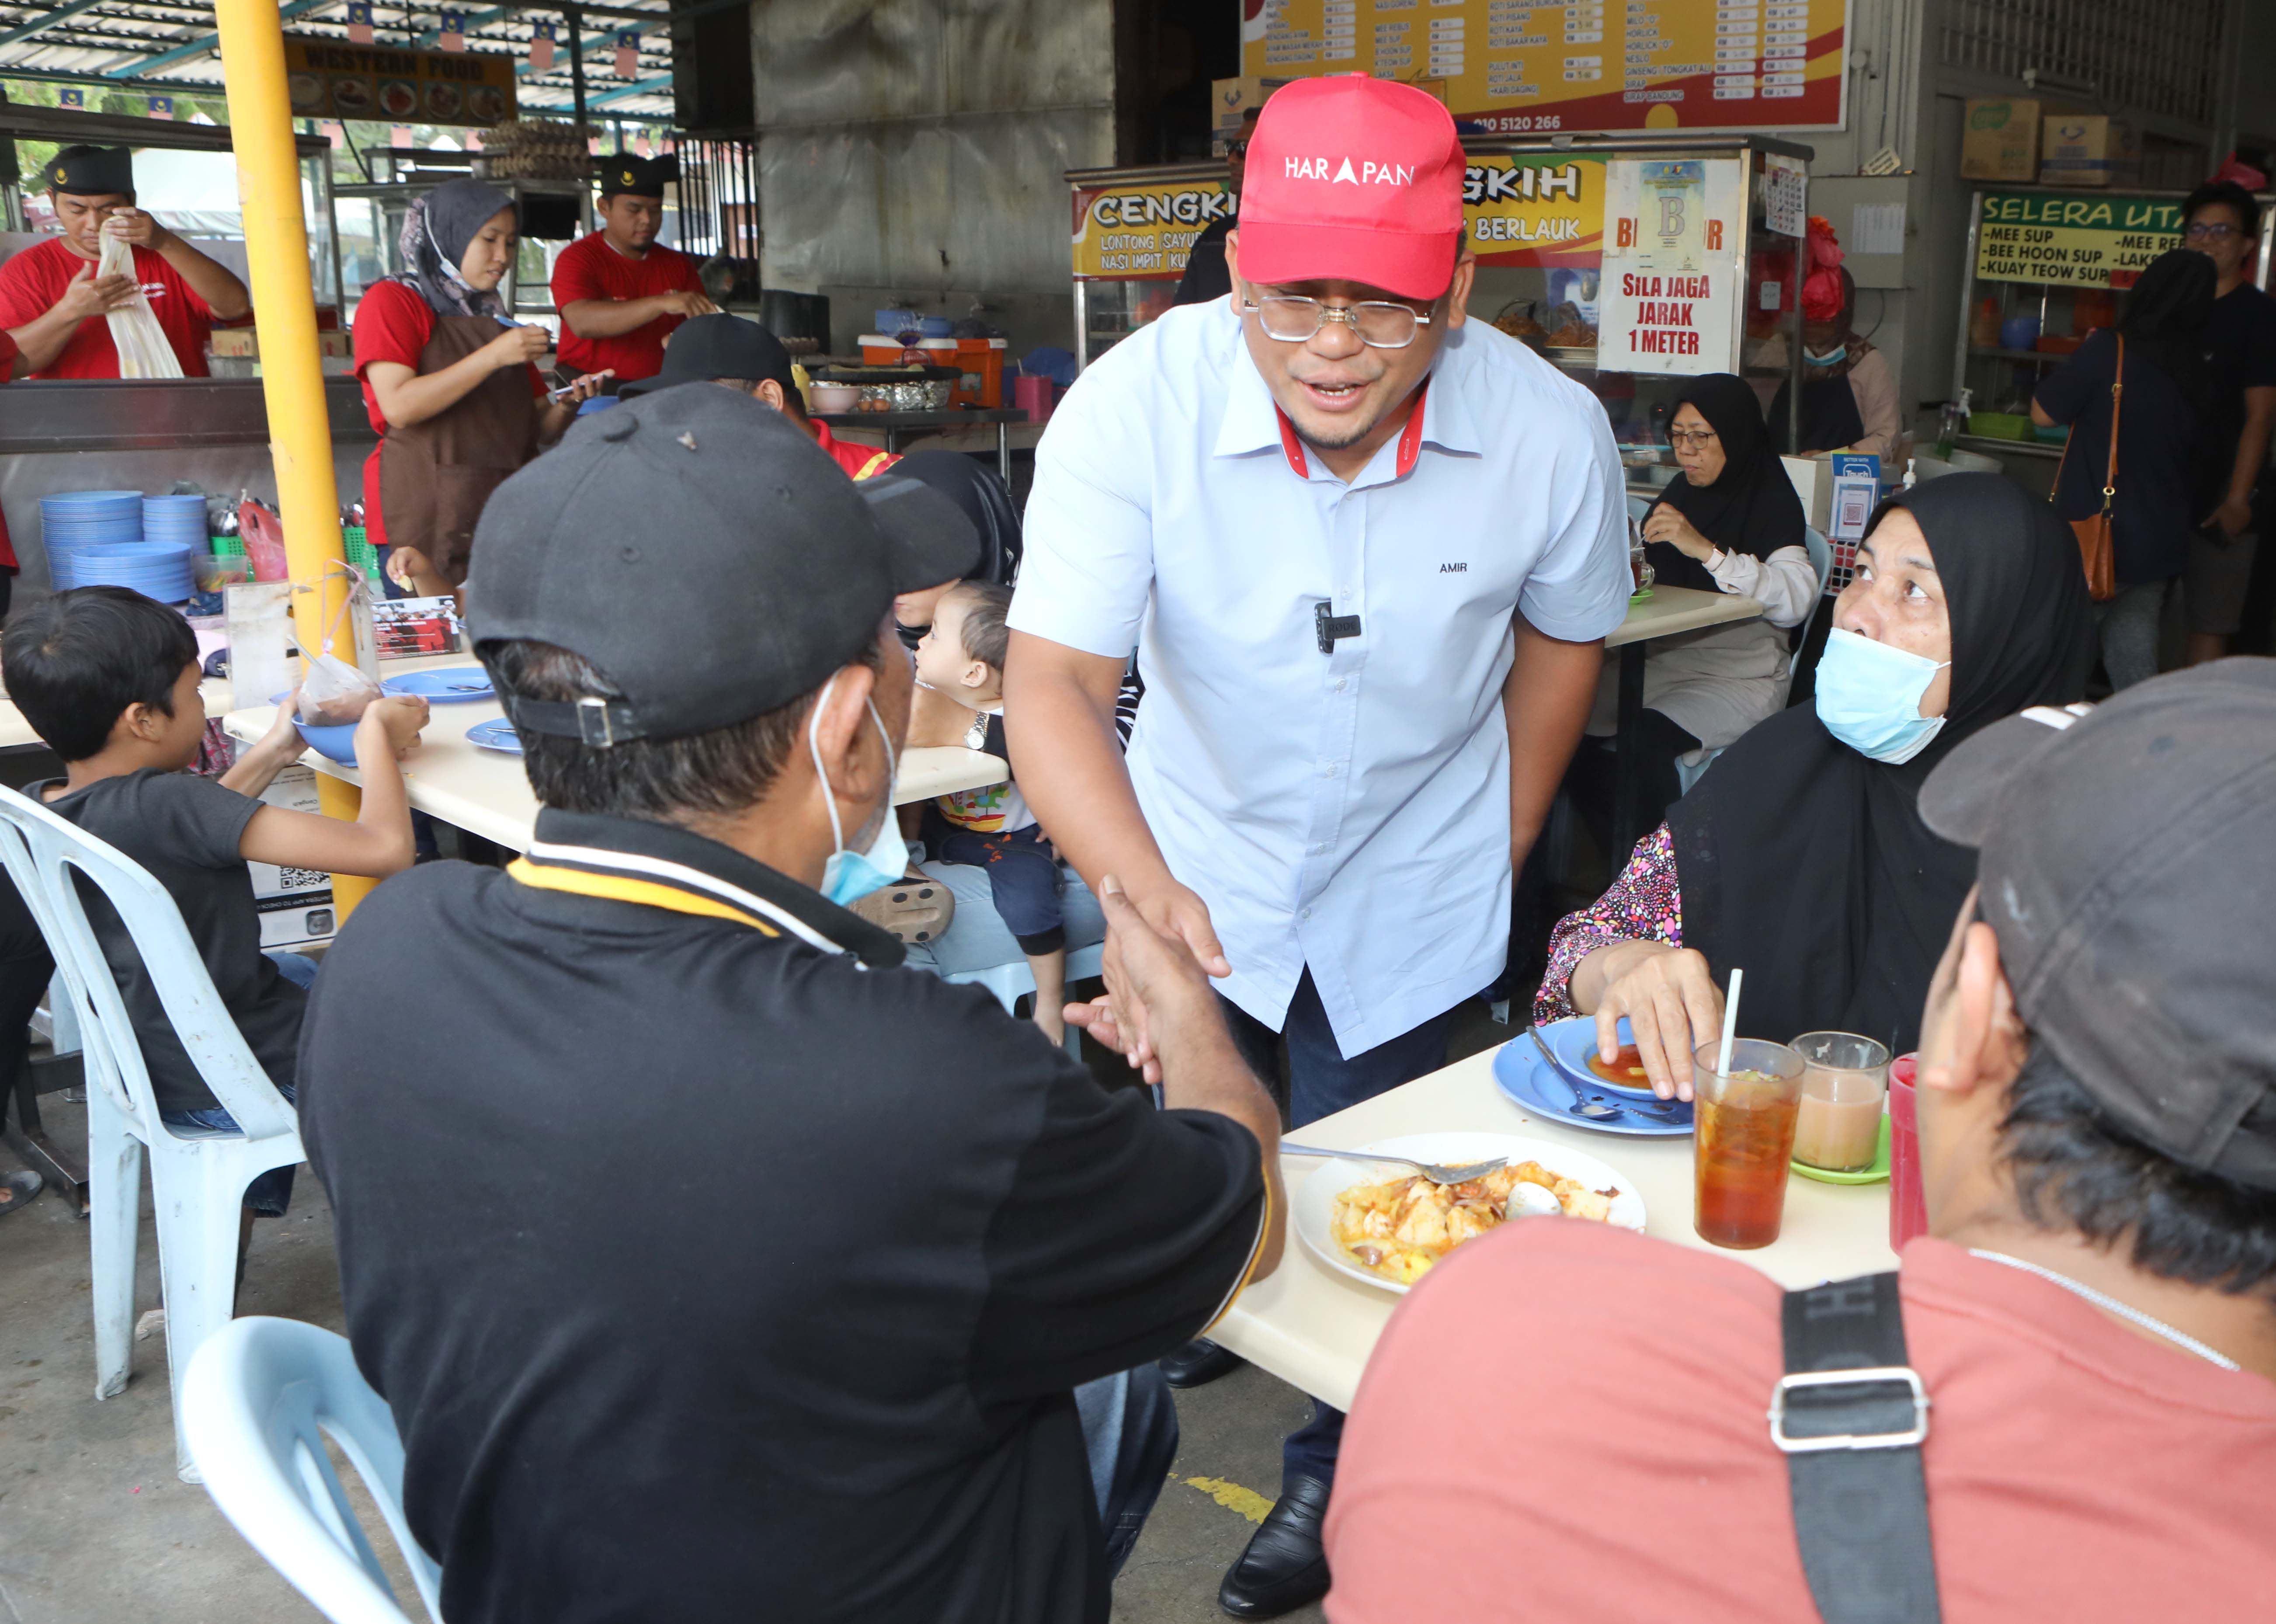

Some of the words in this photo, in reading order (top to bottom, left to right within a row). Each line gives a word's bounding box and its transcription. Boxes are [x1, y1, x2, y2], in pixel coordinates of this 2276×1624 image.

[1489, 1, 1505, 10] ROTI
[1507, 0, 1533, 9] SARANG
[1489, 14, 1505, 23] ROTI
[1489, 26, 1505, 35] ROTI
[1626, 28, 1658, 37] HORLICK
[1489, 38, 1505, 47] ROTI
[1505, 36, 1529, 46] BAKAR
[1626, 41, 1657, 50] HORLICK
[306, 45, 417, 76] WESTERN
[428, 56, 483, 81] FOOD
[1626, 54, 1649, 63] NESLO
[1626, 66, 1657, 76] GINSENG
[1664, 65, 1696, 73] TONGKAT
[1488, 74, 1504, 83] ROTI
[1625, 79, 1646, 88] SIRAP
[1625, 91, 1646, 101] SIRAP
[1647, 90, 1683, 100] BANDUNG
[1501, 117, 1531, 130] 5120
[1535, 116, 1561, 129] 266
[1658, 197, 1685, 236] B
[1984, 197, 2113, 226] SELERA
[1475, 217, 1580, 240] BERLAUK
[1101, 232, 1154, 251] LONTONG
[2024, 229, 2054, 243] SUP
[1101, 252, 1129, 270] NASI
[1132, 252, 1162, 269] IMPIT
[2019, 245, 2068, 261] HOON
[2072, 248, 2103, 264] SUP
[2031, 263, 2074, 279] TEOW
[2078, 265, 2108, 282] SUP
[1623, 273, 1662, 297] SILA
[1666, 275, 1710, 299] JAGA
[1637, 301, 1694, 327] JARAK
[1628, 329, 1637, 352] 1
[1641, 329, 1699, 355] METER
[1439, 563, 1467, 574] AMIR
